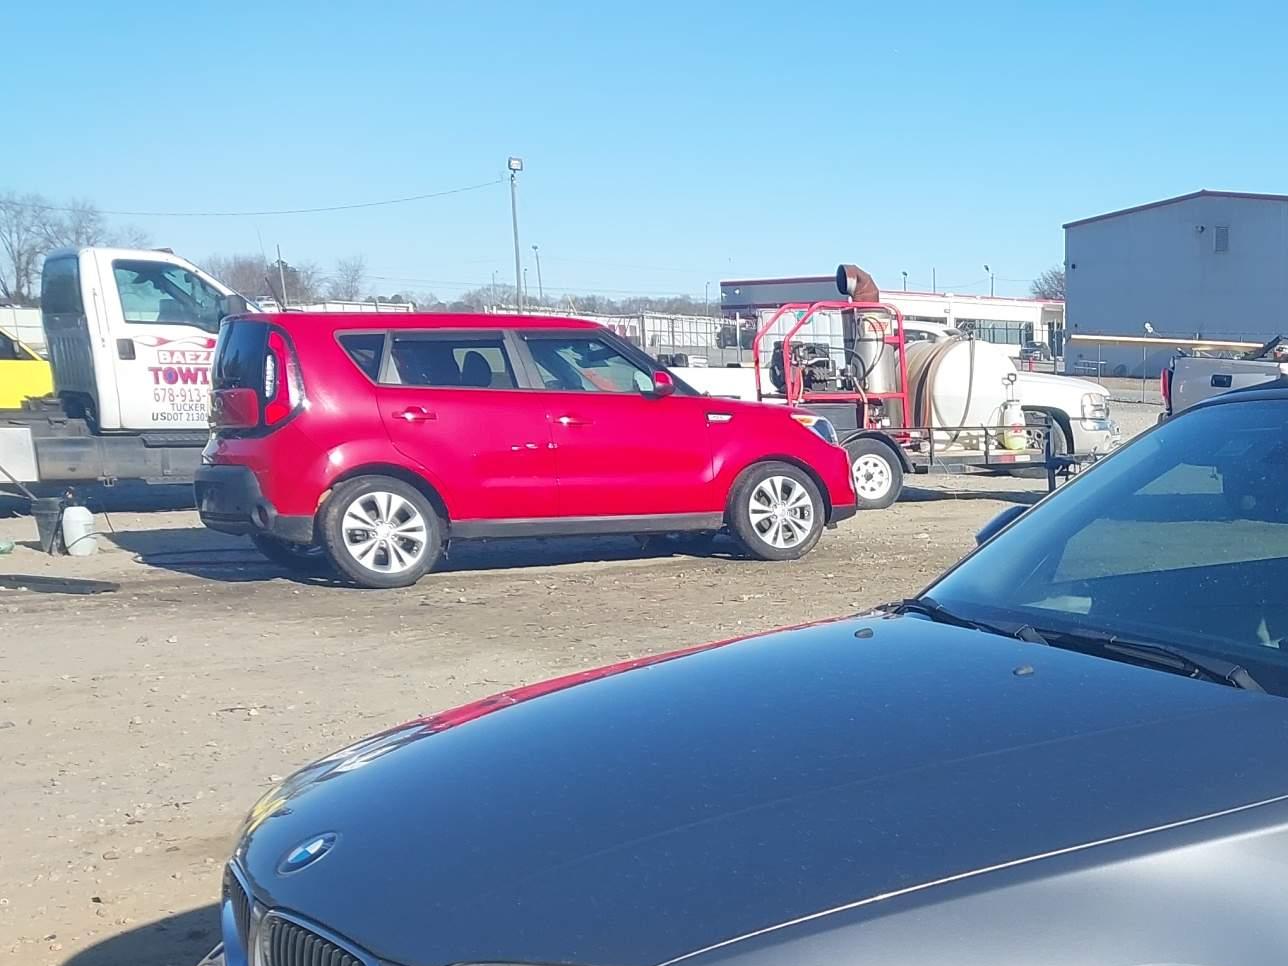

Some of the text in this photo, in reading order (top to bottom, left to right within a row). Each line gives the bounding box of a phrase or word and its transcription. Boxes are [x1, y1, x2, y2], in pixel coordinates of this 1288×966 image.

[148, 366, 212, 385] TOWI
[153, 387, 210, 402] 678-913-
[170, 403, 206, 412] TUCKER
[151, 412, 183, 422] USDOT
